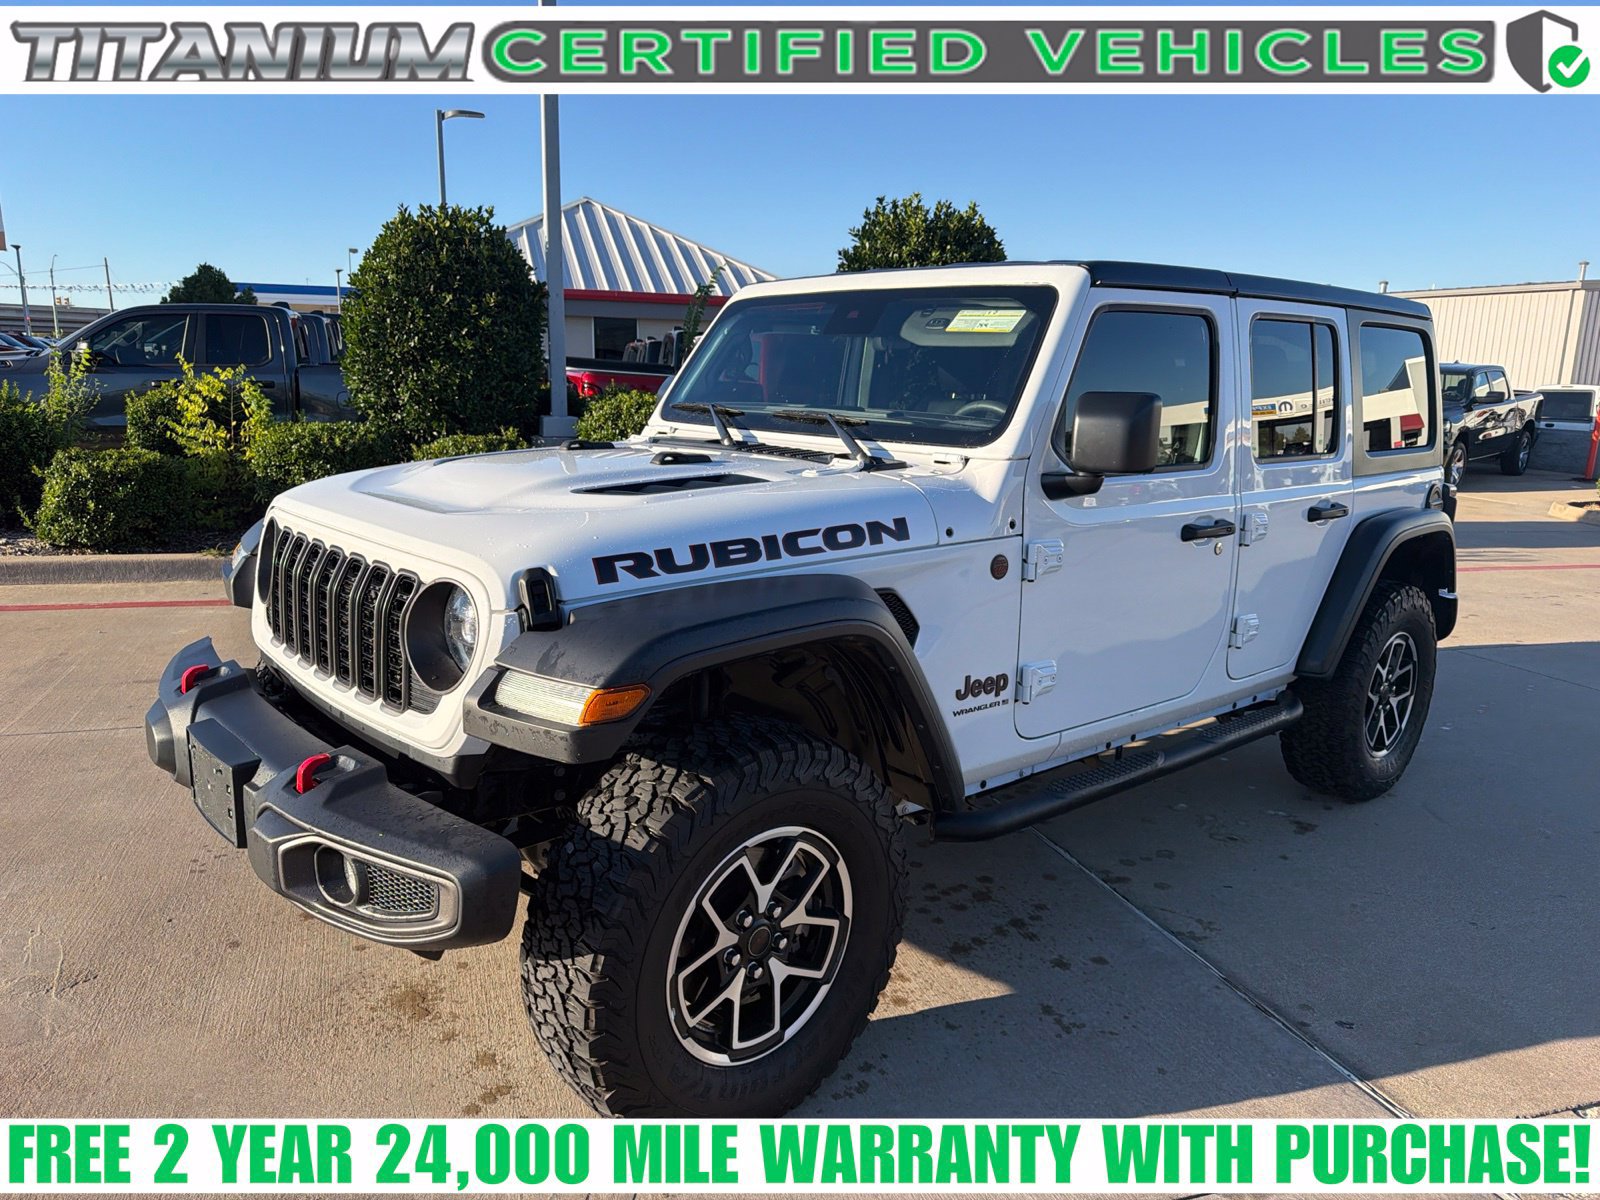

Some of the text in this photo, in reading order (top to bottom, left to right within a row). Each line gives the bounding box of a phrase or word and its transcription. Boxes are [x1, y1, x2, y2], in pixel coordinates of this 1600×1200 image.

[592, 517, 910, 585] RUBICON
[955, 673, 1009, 701] Jeep
[952, 700, 1001, 717] WRANGLER
